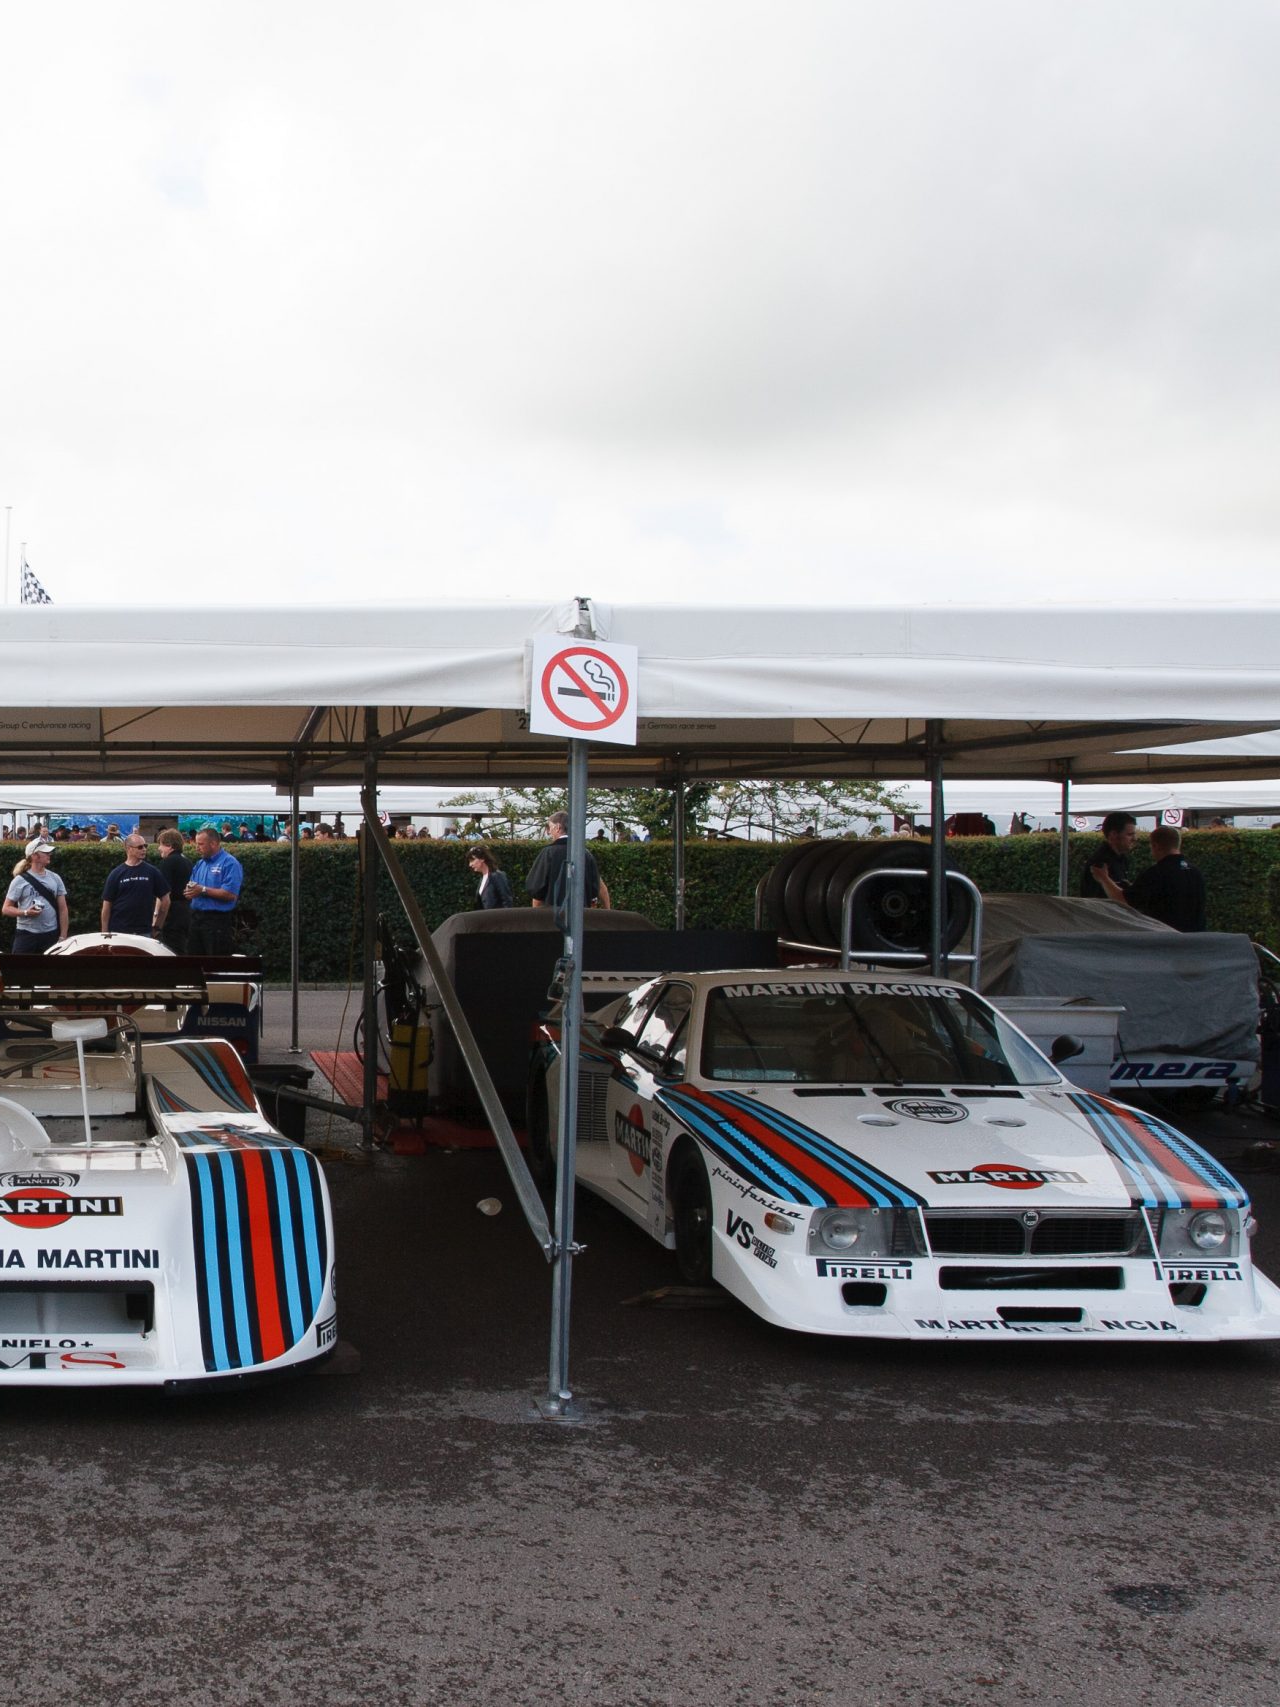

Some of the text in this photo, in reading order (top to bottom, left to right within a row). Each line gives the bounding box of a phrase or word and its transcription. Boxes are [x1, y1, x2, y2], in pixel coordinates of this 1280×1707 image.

[21, 721, 28, 730] C
[28, 720, 67, 730] endurance
[68, 720, 92, 731] racing
[647, 721, 678, 730] German
[678, 722, 696, 730] race
[696, 721, 717, 730] series
[722, 982, 962, 1000] MARTINI RACING
[197, 1016, 247, 1027] NISSAN
[1110, 1061, 1238, 1080] mera
[16, 1177, 59, 1186] LANCIA
[935, 1171, 1081, 1183] MARTINI
[711, 1166, 806, 1221] pininfarina
[725, 1208, 755, 1250] VS
[36, 1248, 161, 1269] MARTINI
[753, 1247, 778, 1269] FIAT
[815, 1257, 913, 1280] PIRELLI
[1152, 1260, 1243, 1281] PIRELLI
